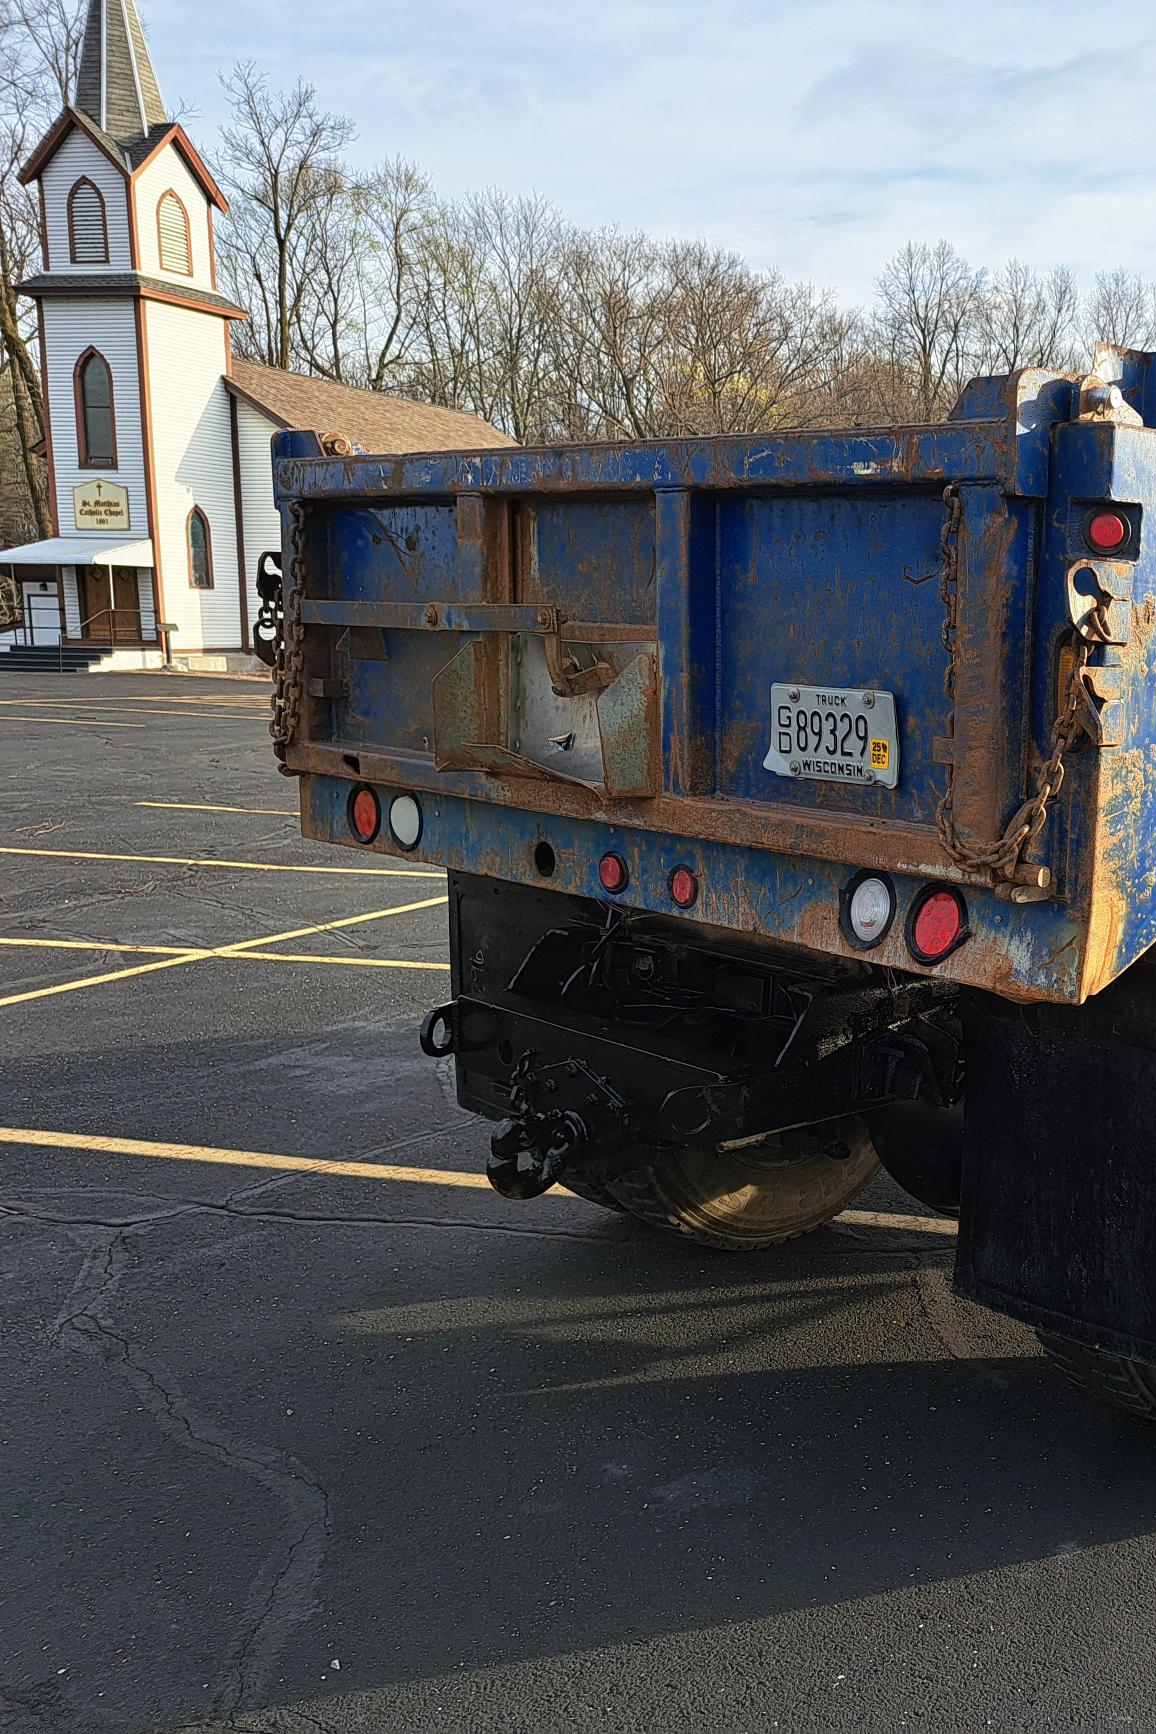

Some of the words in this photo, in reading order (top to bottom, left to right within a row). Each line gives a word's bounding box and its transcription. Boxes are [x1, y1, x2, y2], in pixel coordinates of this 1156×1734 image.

[79, 508, 102, 516] Catholic
[104, 508, 124, 517] Chapel
[816, 694, 848, 707] TRUCK
[796, 709, 868, 758] 89329
[872, 741, 881, 752] 25
[872, 753, 886, 764] DEC
[803, 759, 864, 778] WISCONSIN
